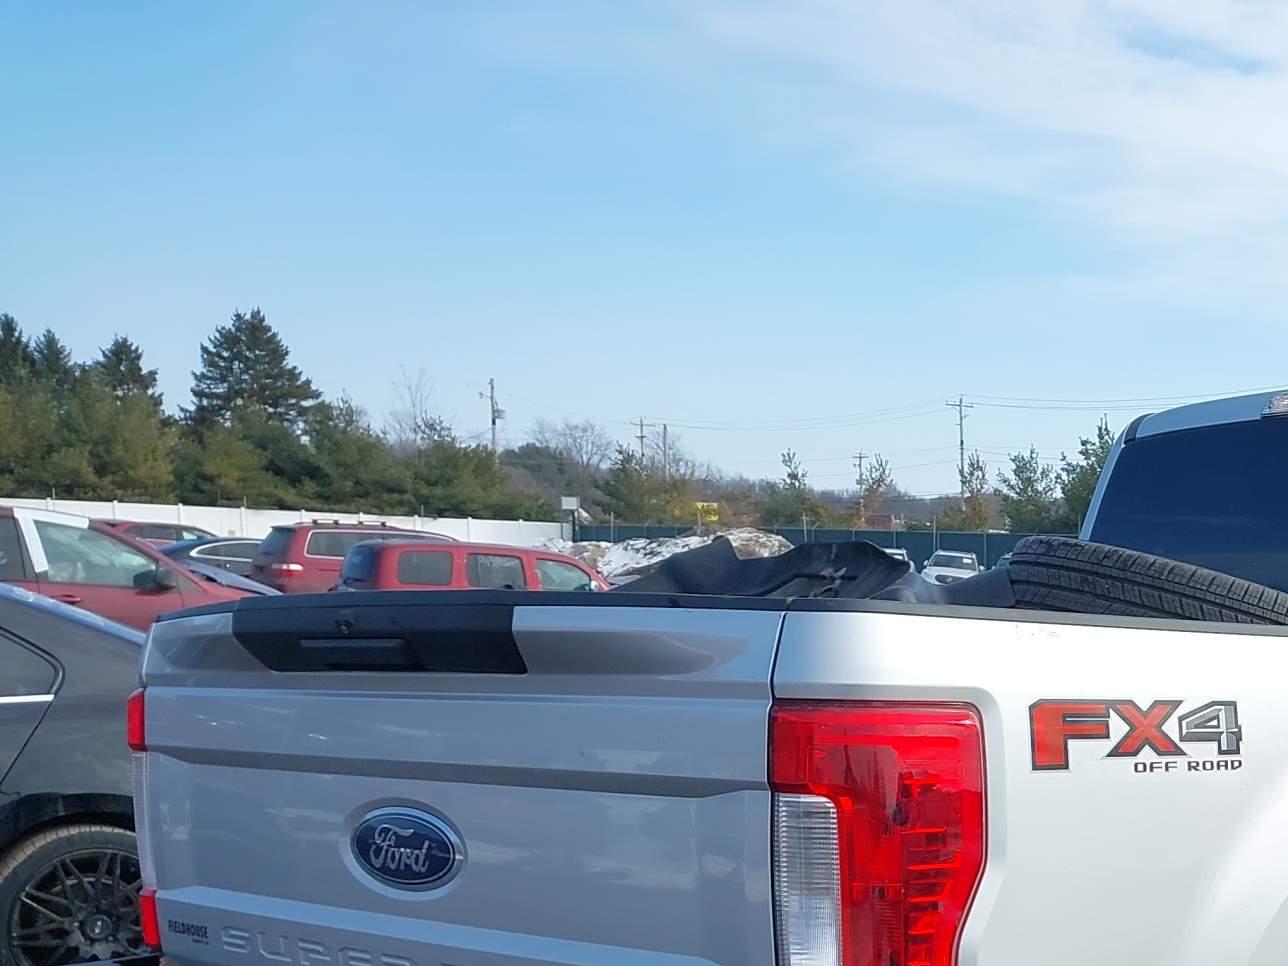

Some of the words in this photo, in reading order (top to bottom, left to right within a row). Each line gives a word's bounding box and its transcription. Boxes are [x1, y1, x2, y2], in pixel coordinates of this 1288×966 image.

[1028, 698, 1243, 771] FX4
[1133, 760, 1179, 774] OFF
[1187, 759, 1243, 773] ROAD
[368, 823, 430, 873] Ford
